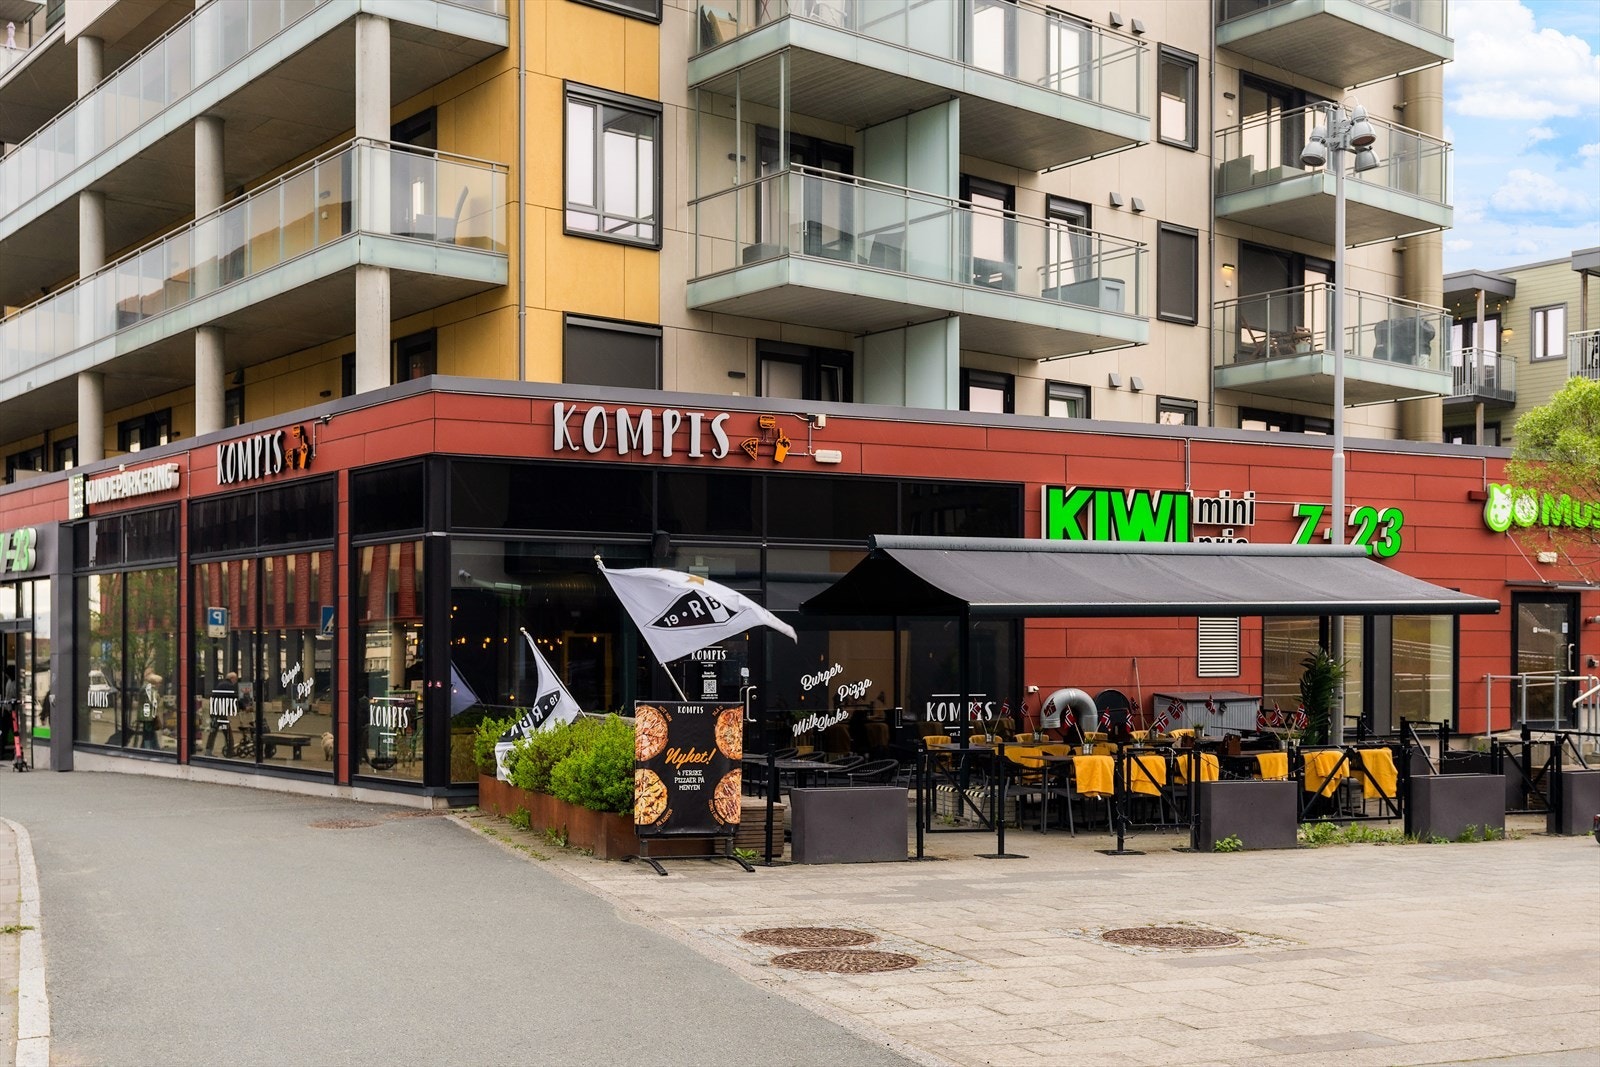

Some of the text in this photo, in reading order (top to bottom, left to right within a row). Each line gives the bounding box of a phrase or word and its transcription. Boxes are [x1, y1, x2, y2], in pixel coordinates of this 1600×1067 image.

[553, 401, 730, 459] KOMPIS
[216, 429, 282, 485] KOMPIS
[85, 463, 179, 504] KUNDEPARKERING
[1042, 485, 1255, 543] KIWI mini
[664, 614, 679, 627] 19
[691, 649, 726, 661] KOMPIS
[801, 662, 843, 691] Burger
[837, 678, 873, 702] Pizza
[209, 696, 238, 717] KOMPIS
[369, 704, 409, 729] KOMPIS
[677, 705, 704, 714] KOMPIS
[664, 746, 717, 770] Nyhet!
[682, 769, 703, 777] FERSKE
